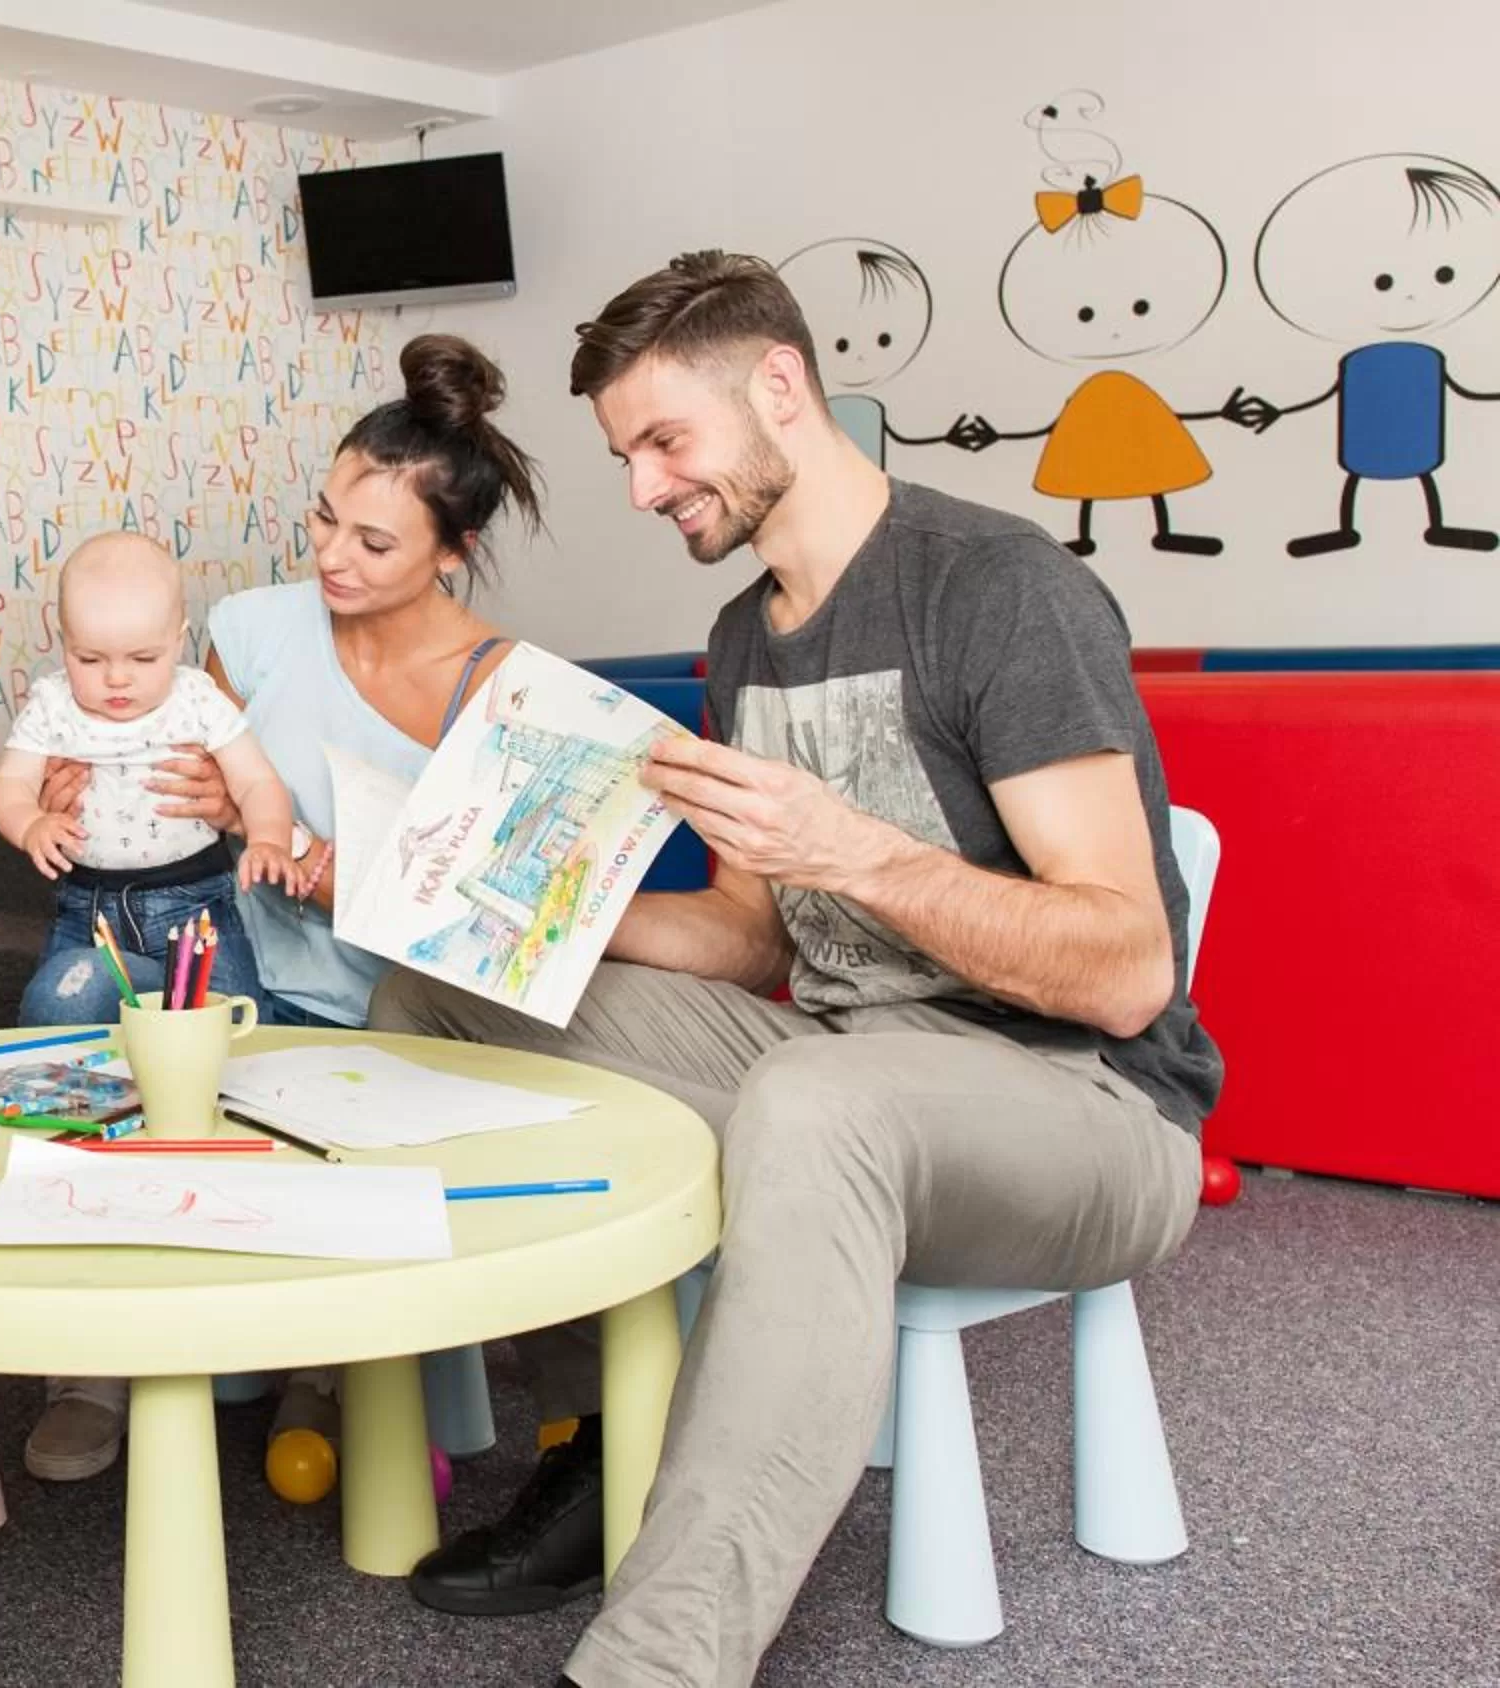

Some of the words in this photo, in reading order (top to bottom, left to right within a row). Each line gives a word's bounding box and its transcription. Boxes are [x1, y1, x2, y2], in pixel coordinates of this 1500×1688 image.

[413, 854, 457, 905] IKAR
[448, 807, 484, 849] PLAZA
[579, 797, 667, 928] KOLOROWANK
